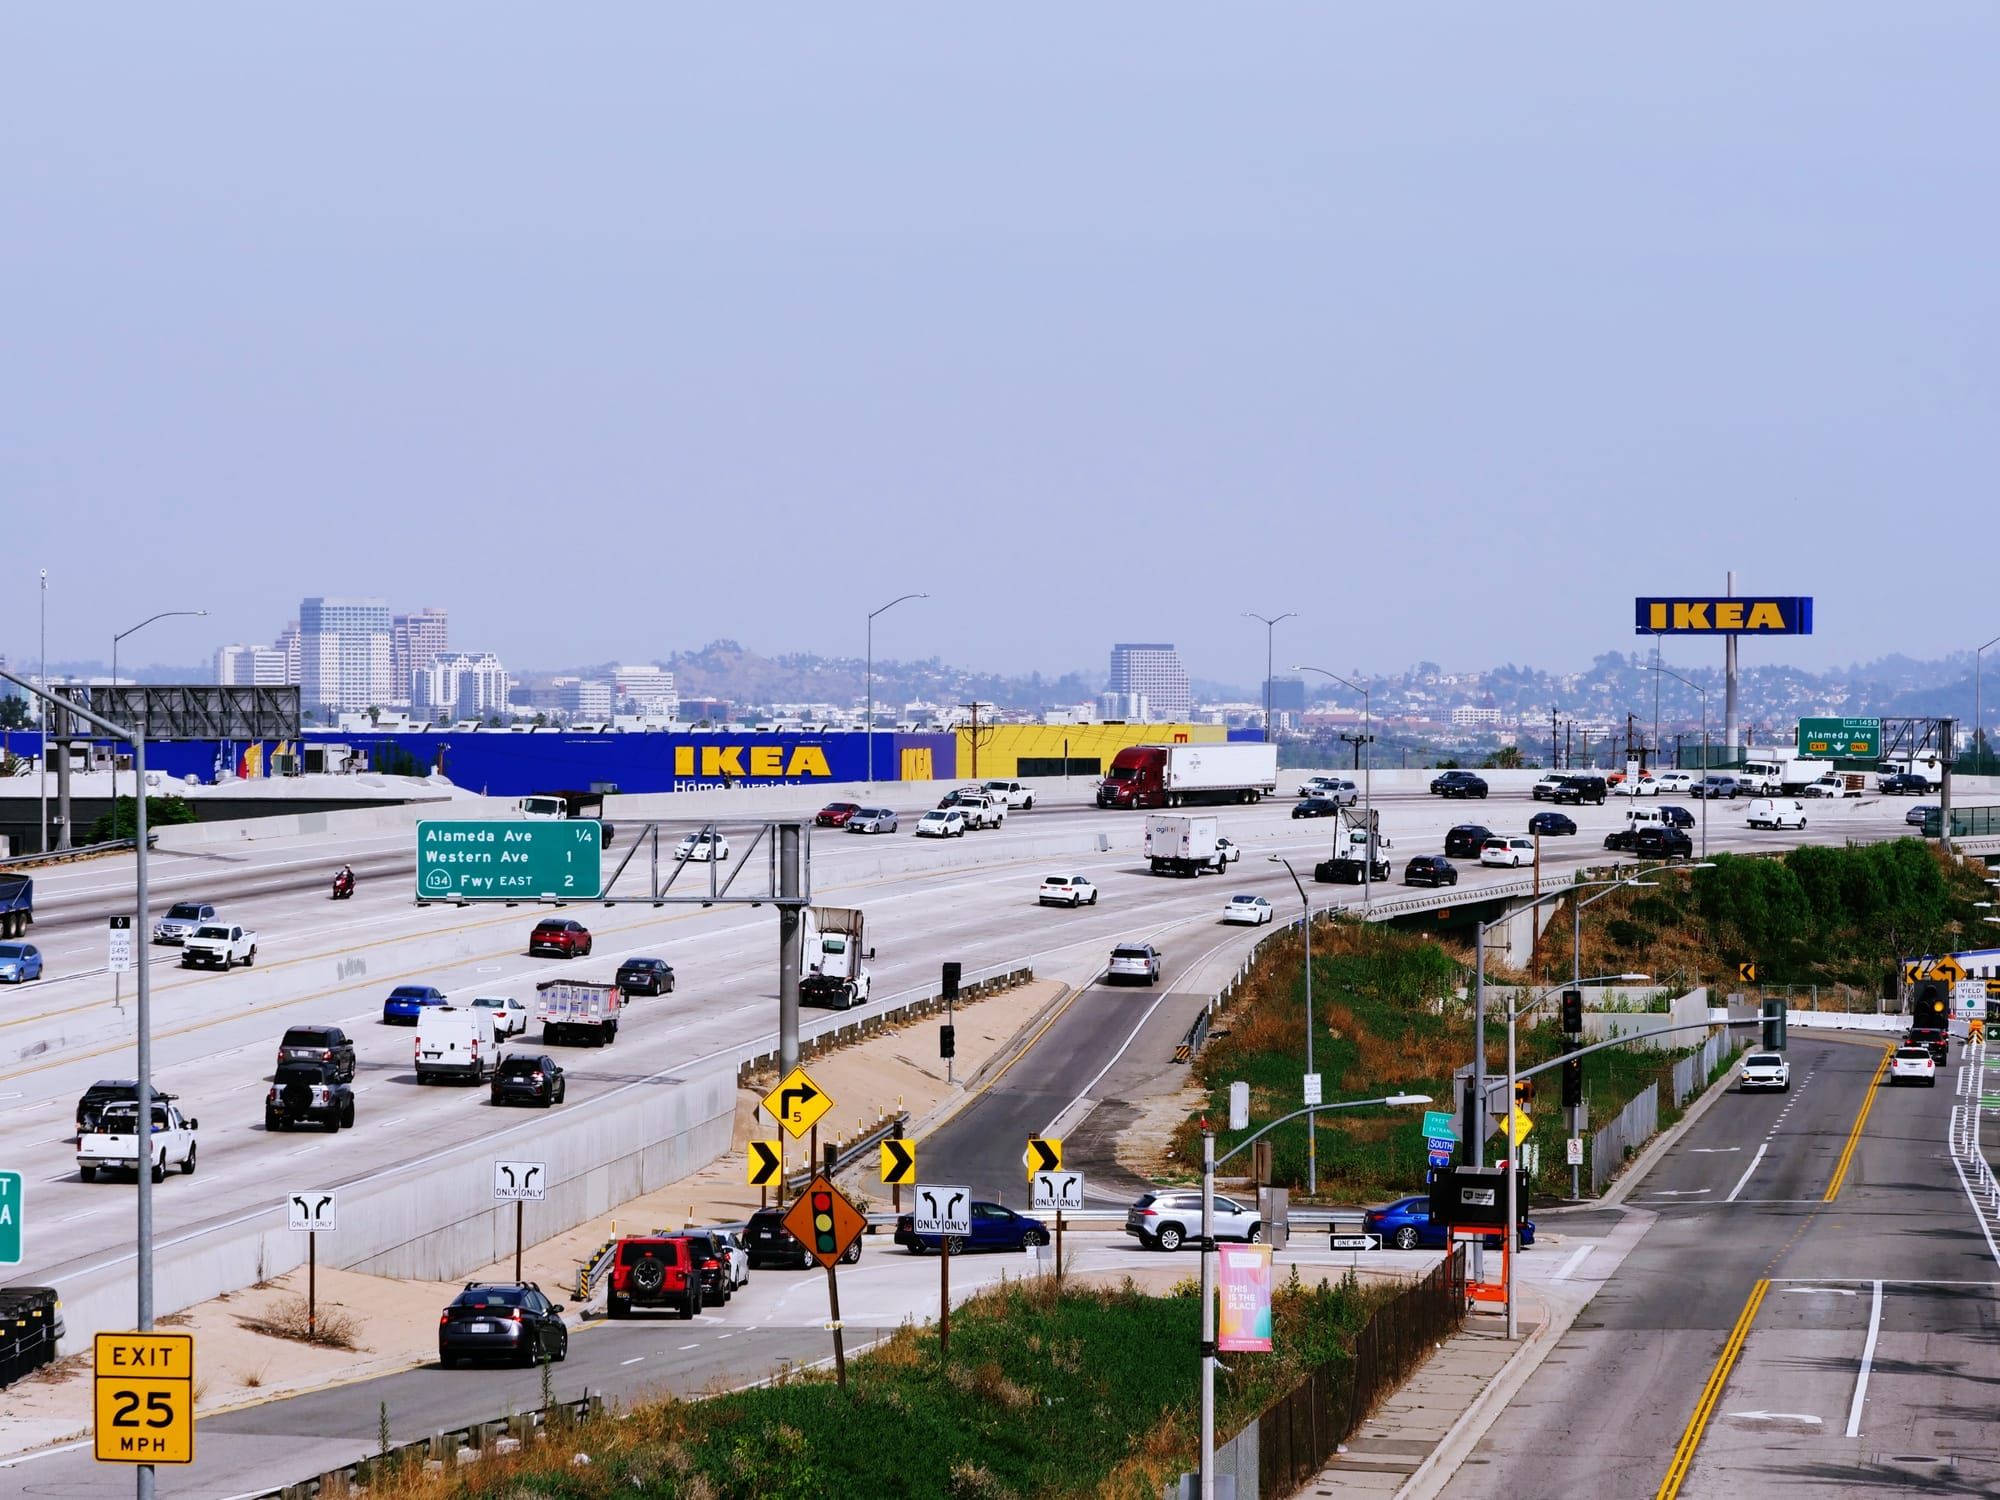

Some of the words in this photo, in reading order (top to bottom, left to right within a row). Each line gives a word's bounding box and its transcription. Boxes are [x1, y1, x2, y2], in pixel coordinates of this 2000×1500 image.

[1650, 603, 1786, 629] IKEA
[1807, 731, 1849, 739] Alameda
[1854, 731, 1872, 739] Ave
[674, 746, 832, 776] IKEA
[1155, 826, 1176, 834] agilti
[426, 830, 495, 842] Alameda
[503, 830, 532, 842] Ave
[575, 829, 592, 843] 1/4
[426, 851, 491, 863] Western
[500, 851, 529, 863] Ave
[566, 851, 572, 863] 1
[430, 876, 448, 886] 134
[460, 875, 493, 889] Fwy
[500, 876, 533, 886] EAST
[564, 875, 574, 887] 2
[793, 1112, 802, 1122] 5
[1430, 1139, 1453, 1150] SOUTH
[496, 1188, 518, 1196] ONLY
[521, 1189, 543, 1197] ONLY
[1035, 1198, 1057, 1207] ONLY
[1059, 1198, 1081, 1207] ONLY
[291, 1220, 309, 1228] ONLY
[314, 1220, 332, 1228] ONLY
[917, 1219, 941, 1230] ONLY
[944, 1220, 968, 1231] ONLY
[1228, 1285, 1248, 1293] THIS
[1228, 1293, 1237, 1301] IS
[1239, 1294, 1256, 1302] THE
[1228, 1302, 1256, 1310] PLACE
[113, 1347, 173, 1367] EXIT
[112, 1390, 174, 1429] 25
[120, 1437, 165, 1452] MPH
